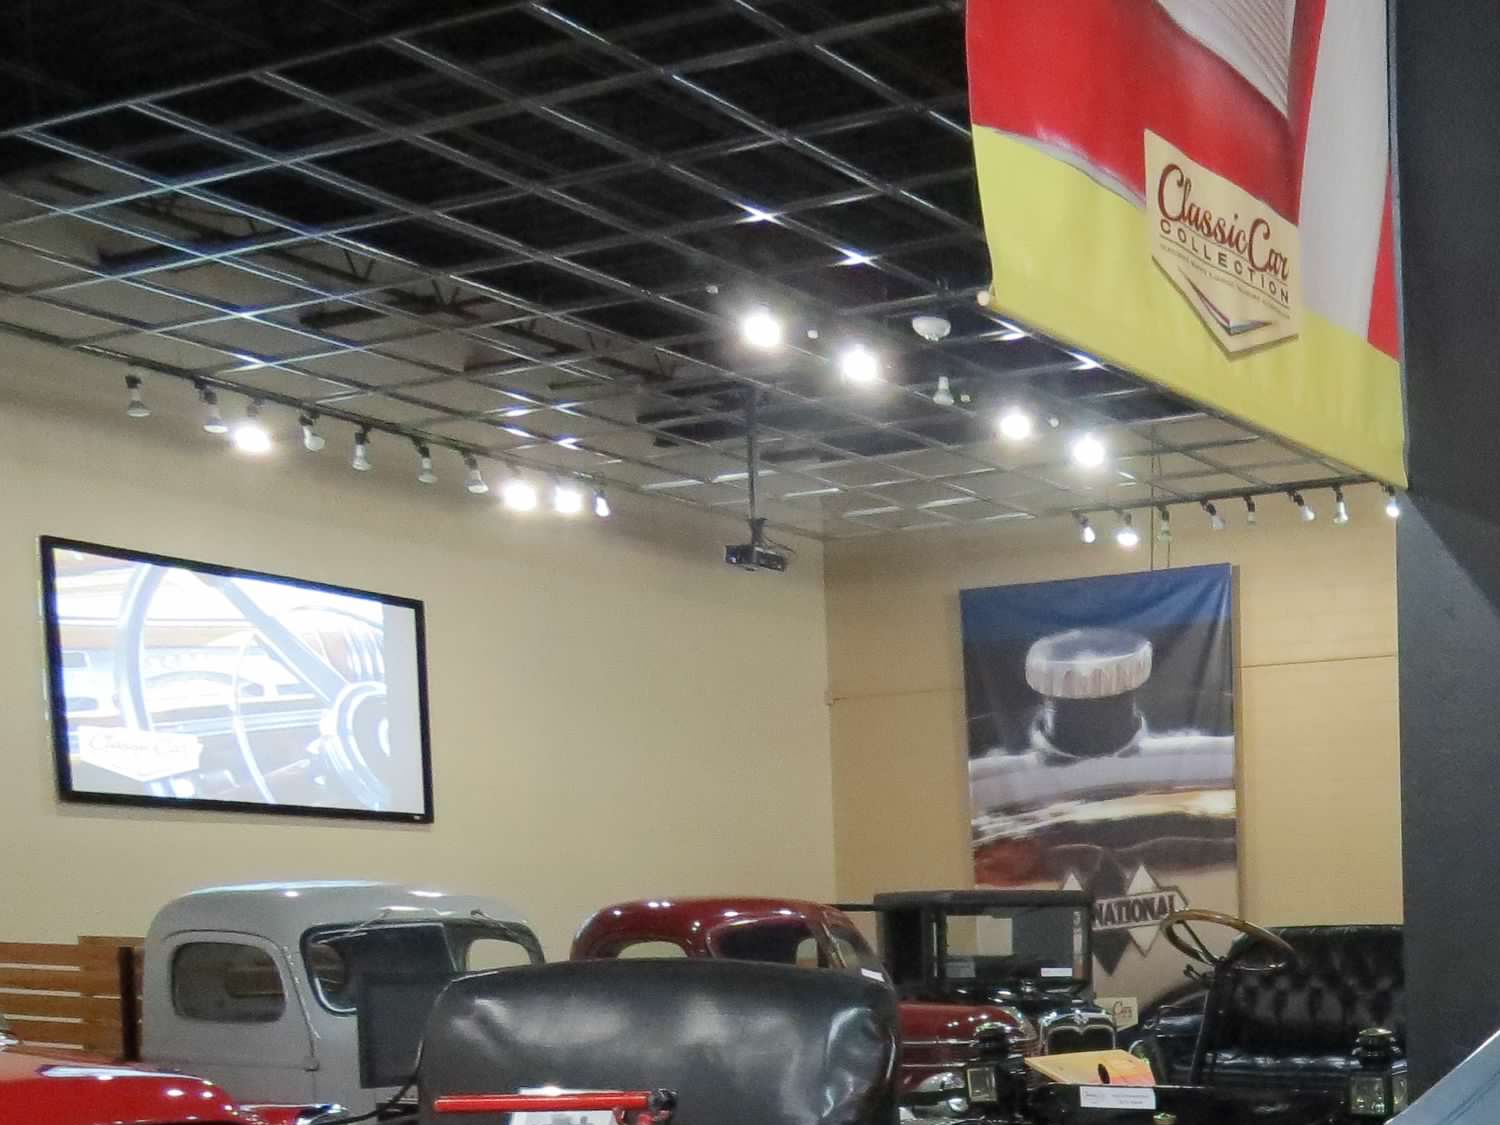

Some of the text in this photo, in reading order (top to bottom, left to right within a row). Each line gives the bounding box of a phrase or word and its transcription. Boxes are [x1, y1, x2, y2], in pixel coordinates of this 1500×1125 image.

[1158, 164, 1289, 281] Classic Car
[1160, 218, 1289, 305] COLLECTION
[1095, 894, 1176, 928] NATIONAL
